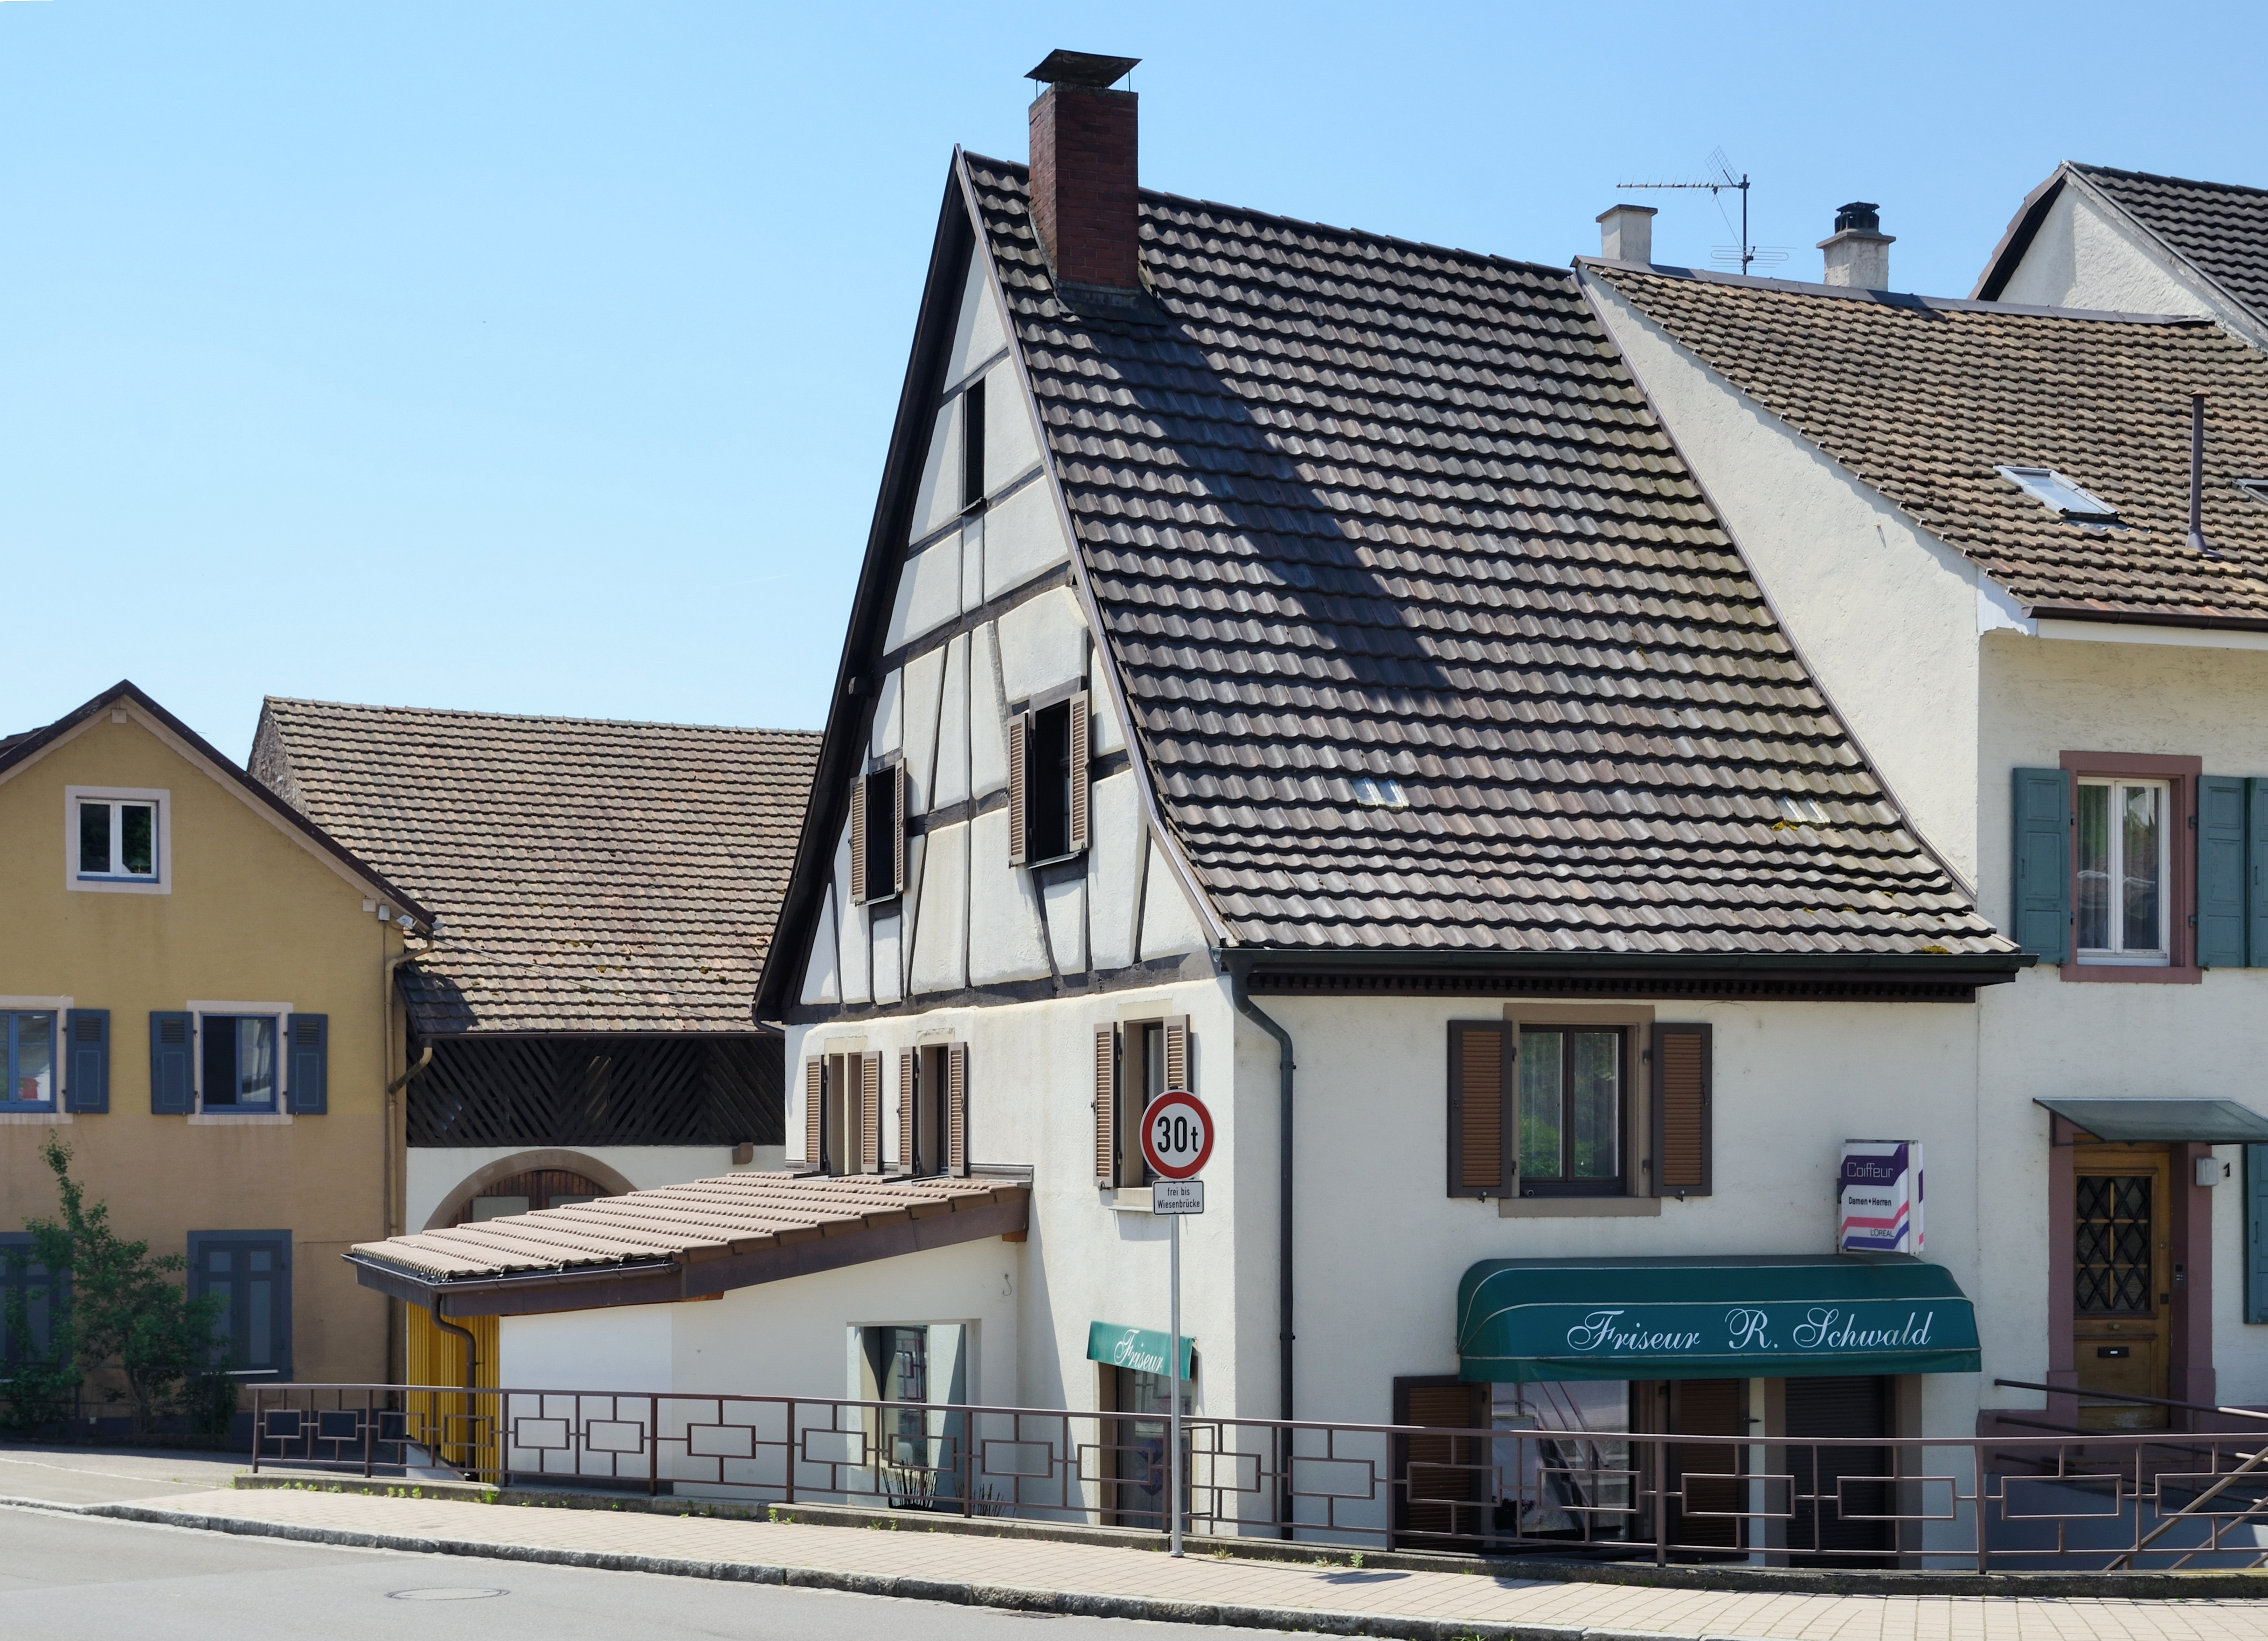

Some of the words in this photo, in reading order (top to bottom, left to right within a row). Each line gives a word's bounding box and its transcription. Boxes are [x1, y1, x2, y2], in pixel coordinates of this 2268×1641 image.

[1847, 1162, 1894, 1178] Coiffeur
[1167, 1187, 1178, 1196] frei
[1181, 1187, 1190, 1195] bis
[1157, 1199, 1200, 1208] Wiesenbrücke
[1567, 1310, 1701, 1350] Friseur
[1724, 1308, 1778, 1348] R.
[1792, 1307, 1934, 1347] Schwald
[1114, 1329, 1163, 1372] Friseur
